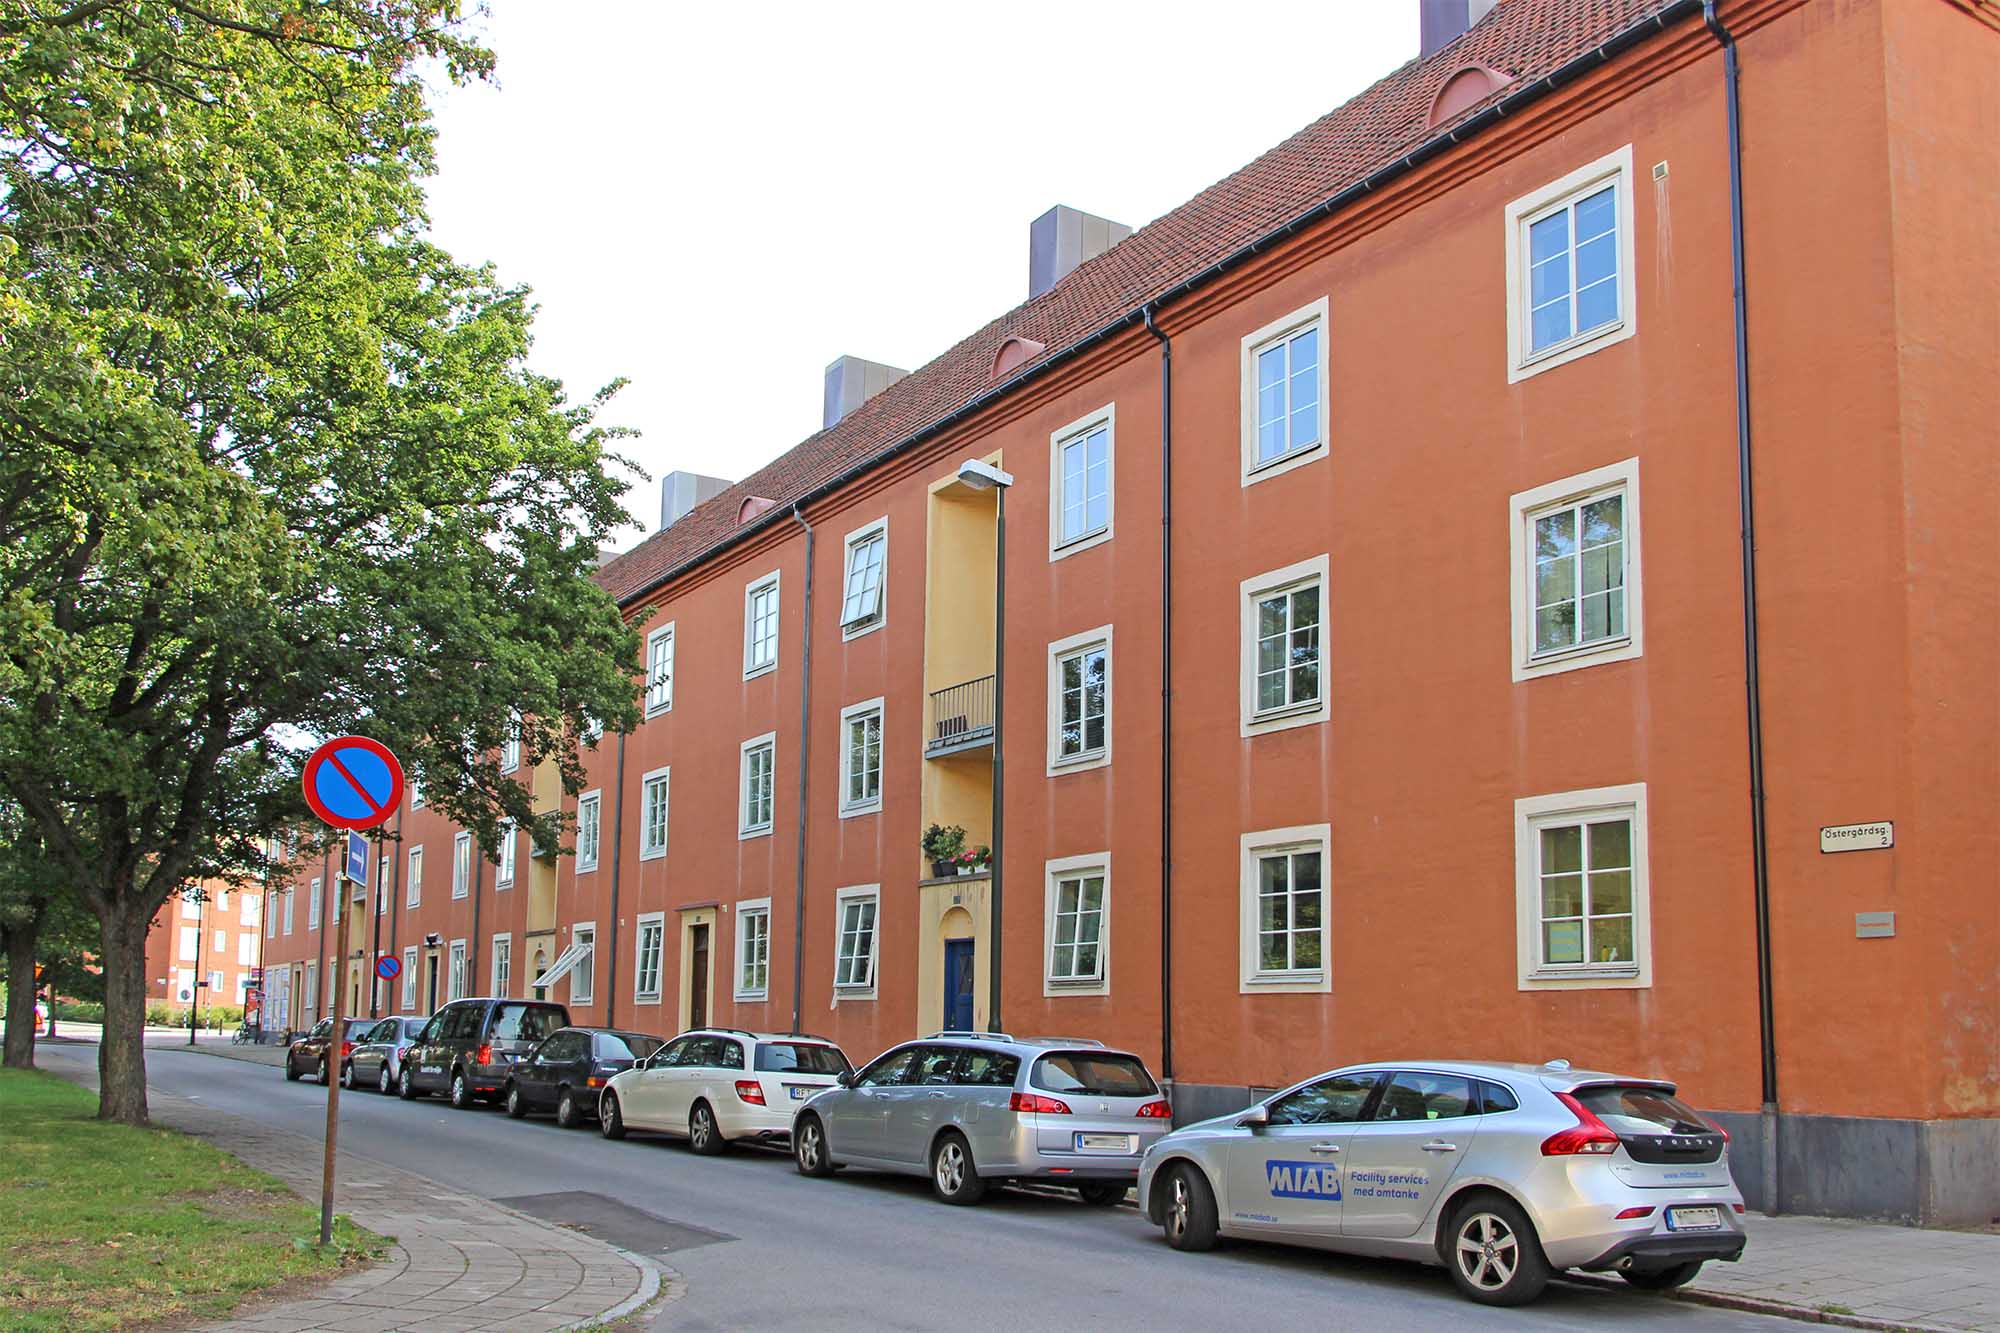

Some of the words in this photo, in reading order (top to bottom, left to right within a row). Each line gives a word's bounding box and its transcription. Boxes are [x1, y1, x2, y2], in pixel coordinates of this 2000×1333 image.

[1825, 827, 1888, 838] Östergårdsg.
[1881, 837, 1888, 845] 2
[1270, 1166, 1339, 1194] MIAB
[1351, 1171, 1386, 1185] Facility
[1388, 1174, 1429, 1185] services
[1353, 1187, 1374, 1196] med
[1376, 1189, 1420, 1199] omtanke
